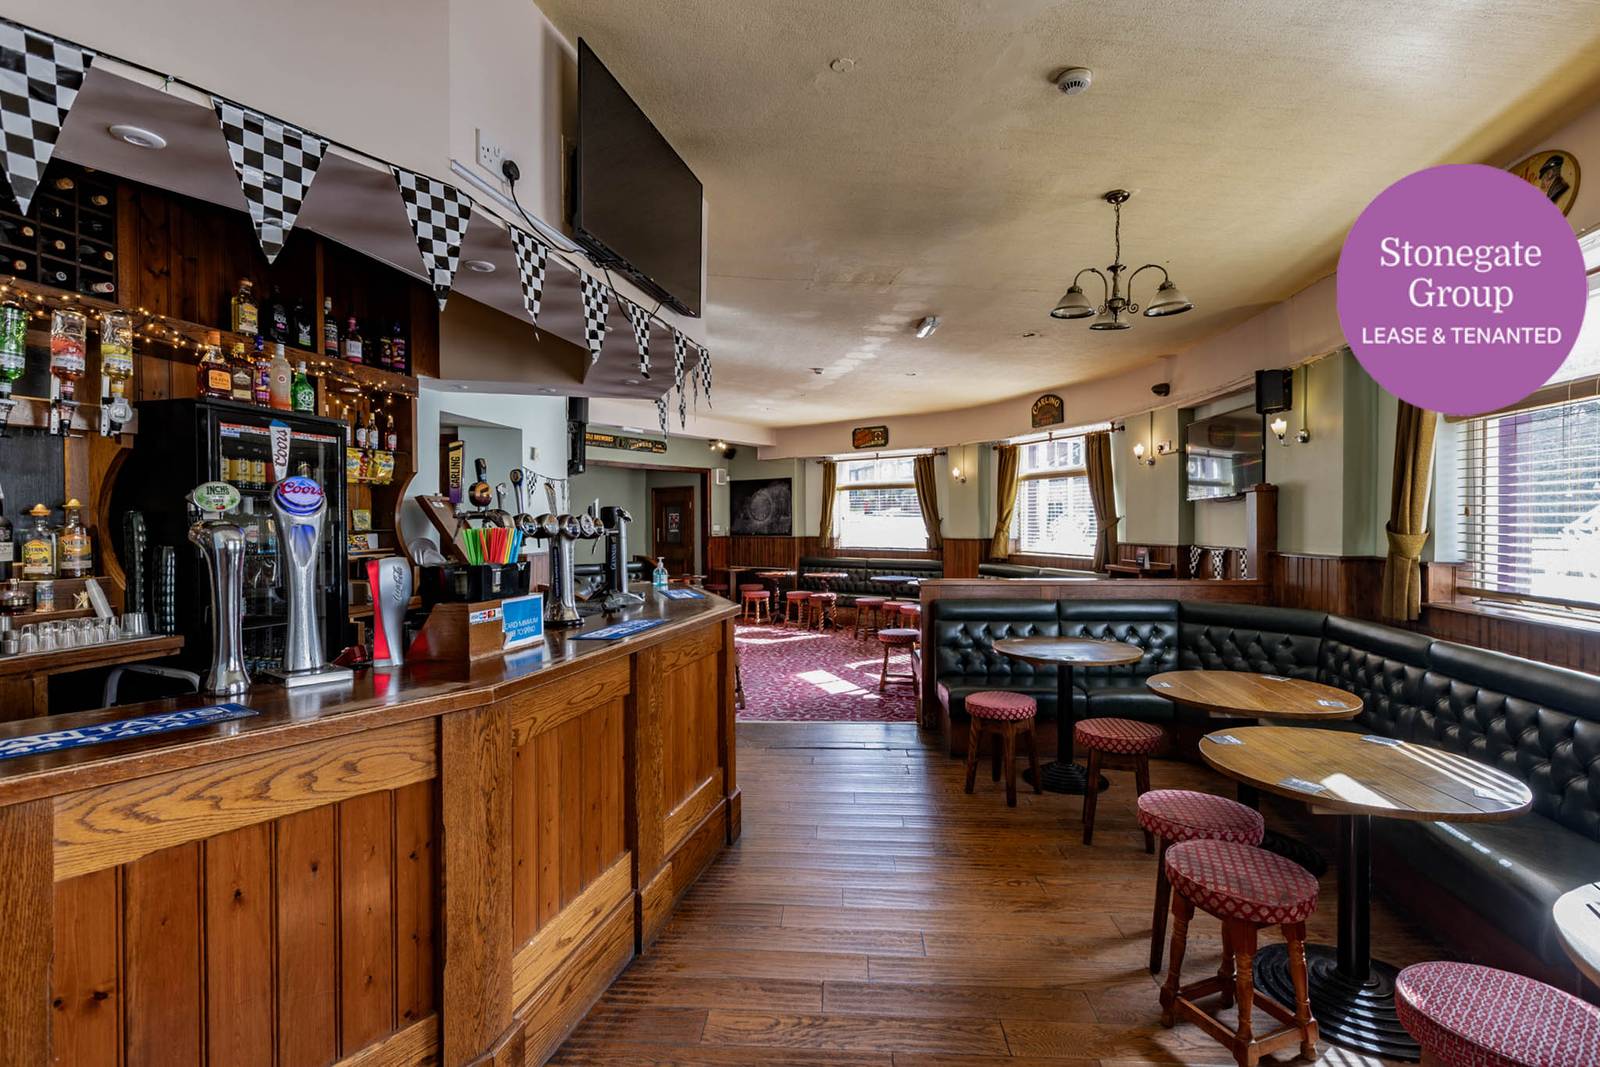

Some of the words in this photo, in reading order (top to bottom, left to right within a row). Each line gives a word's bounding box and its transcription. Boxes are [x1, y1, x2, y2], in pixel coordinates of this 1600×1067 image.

[1032, 396, 1060, 415] CARLING
[274, 429, 288, 468] Coors
[450, 456, 461, 489] CARLING
[279, 481, 324, 496] Coors
